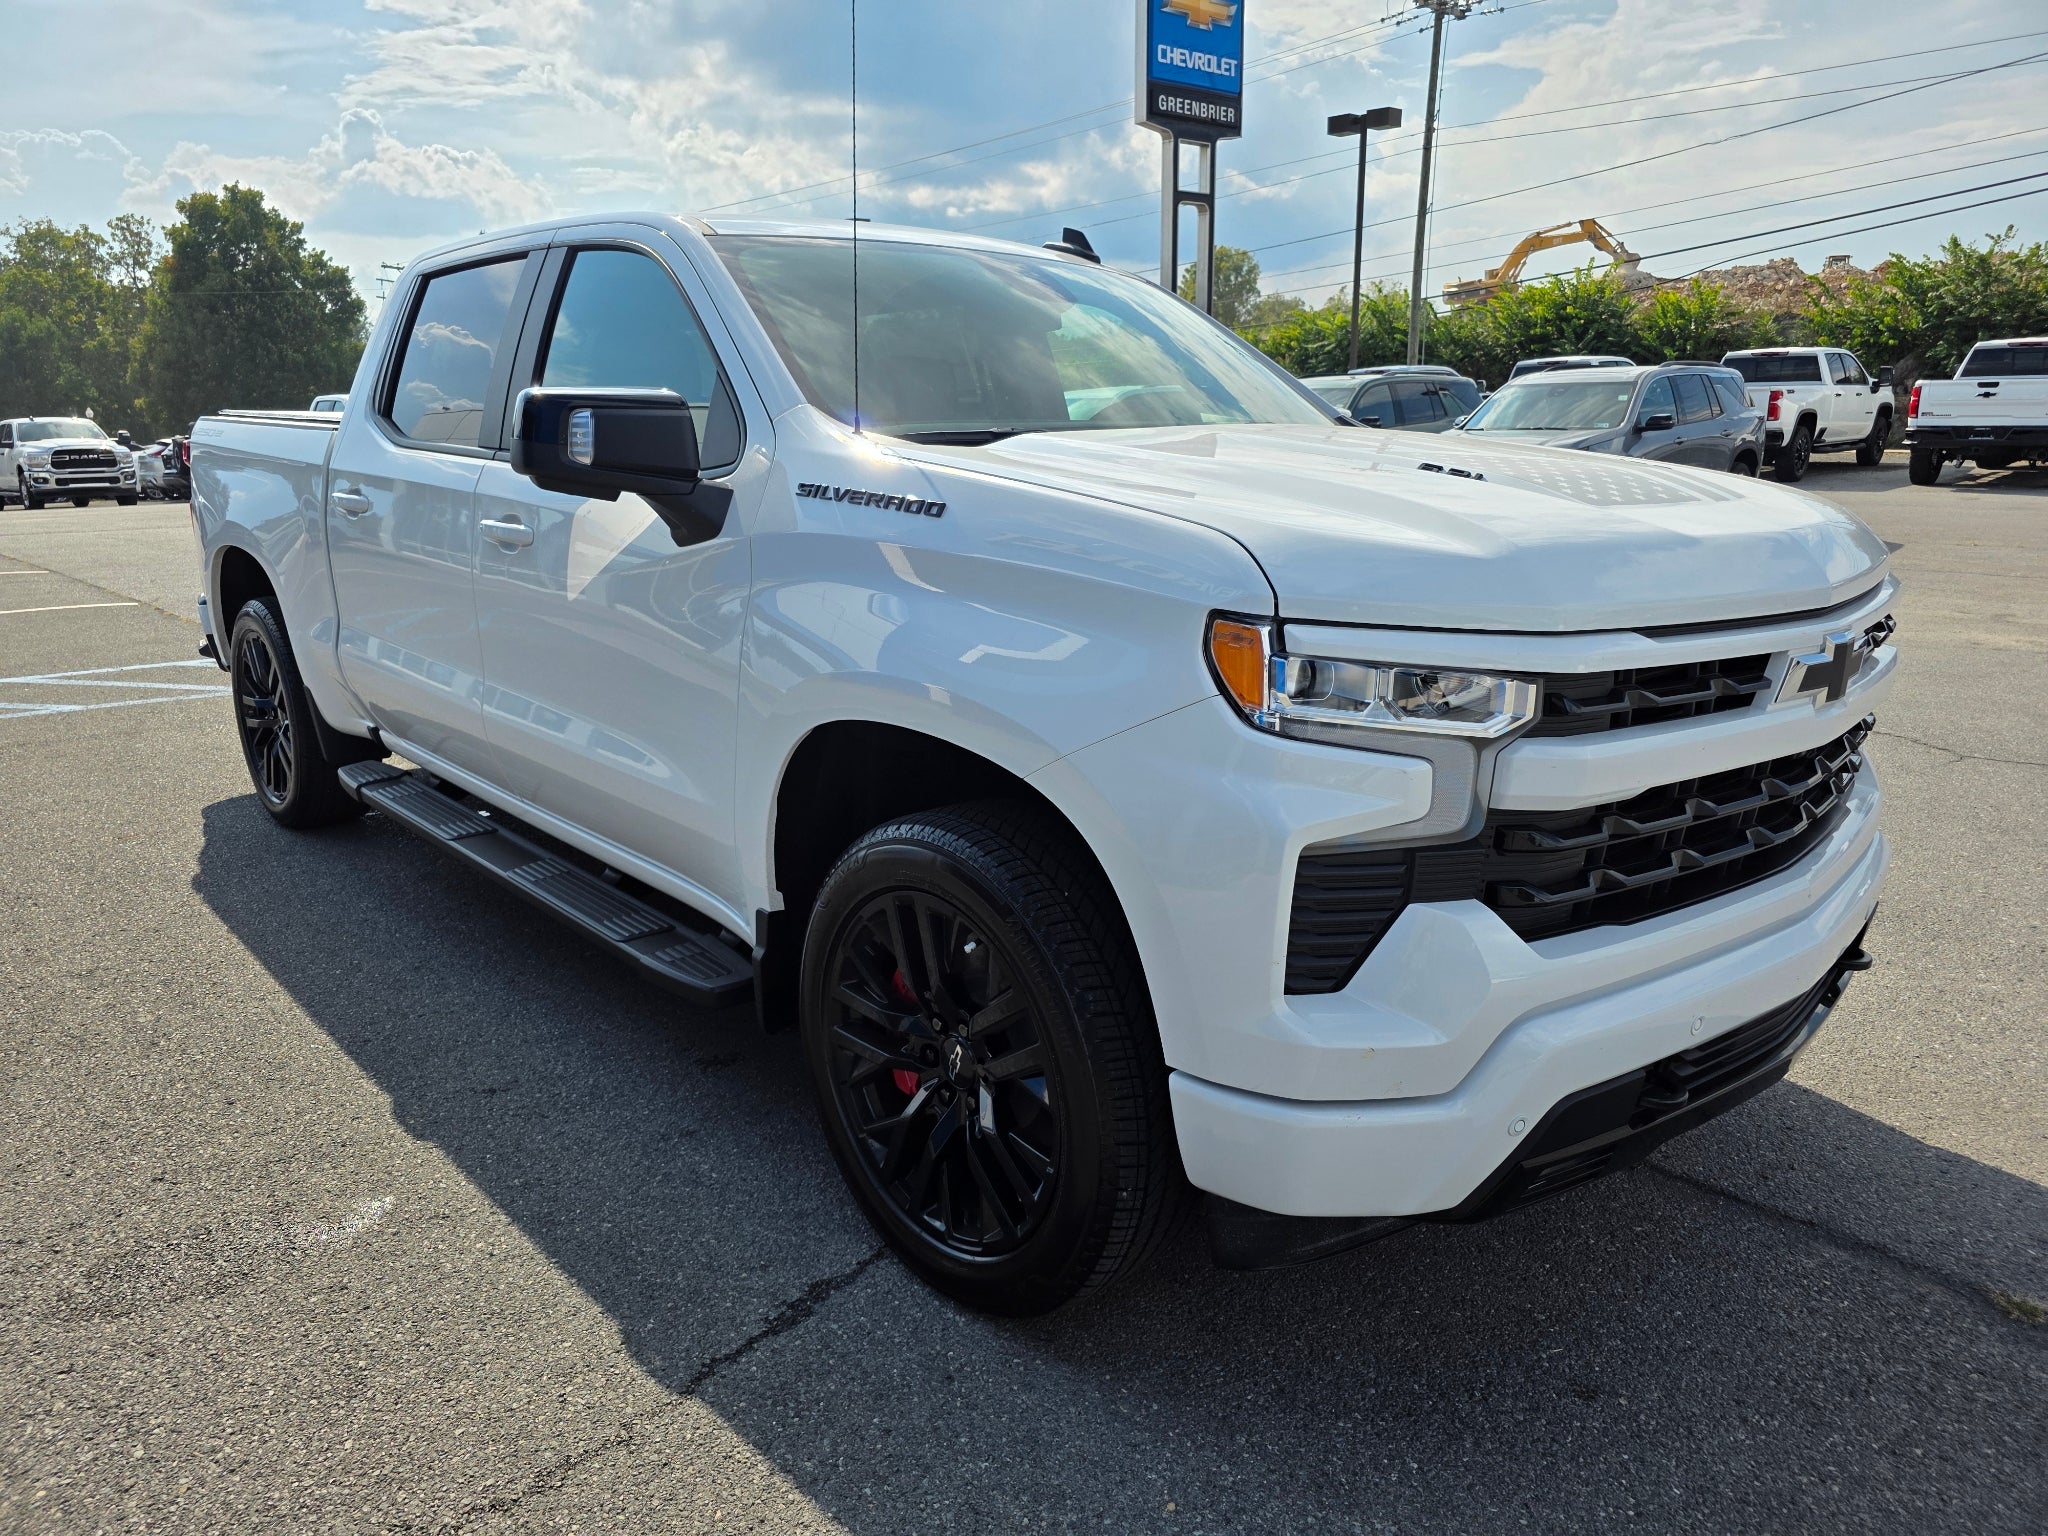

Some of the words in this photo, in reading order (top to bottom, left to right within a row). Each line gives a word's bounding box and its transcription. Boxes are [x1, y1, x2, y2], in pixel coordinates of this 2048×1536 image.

[1157, 44, 1238, 77] CHEVROLET
[1158, 94, 1235, 123] GREENBRIER
[795, 482, 948, 519] SILVERADO
